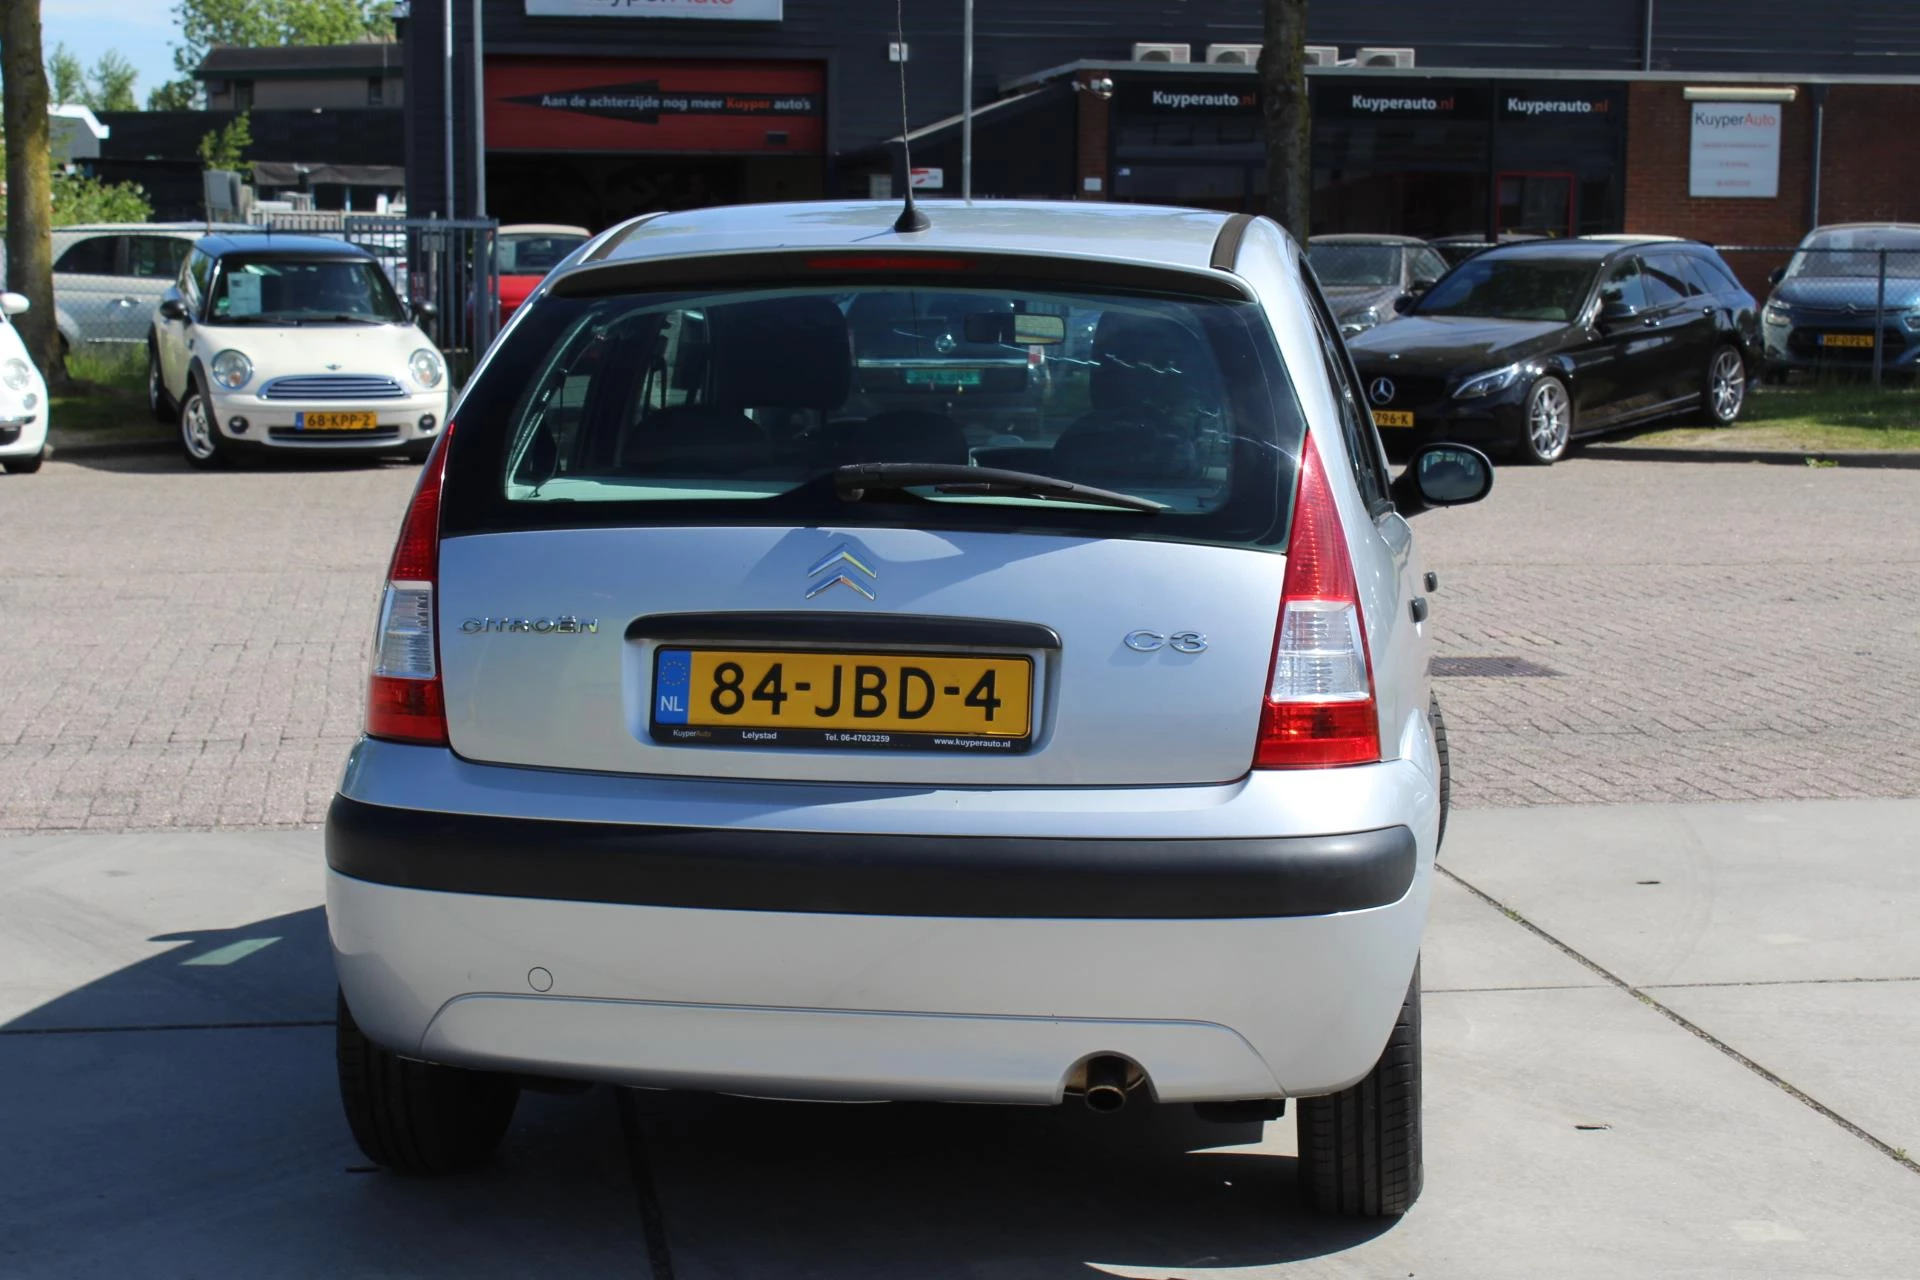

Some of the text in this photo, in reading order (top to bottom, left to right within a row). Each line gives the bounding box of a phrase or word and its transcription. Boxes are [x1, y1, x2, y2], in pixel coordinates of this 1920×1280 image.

[542, 95, 811, 111] Aan de achterzijde nog meer Kuyper auto's
[1153, 90, 1256, 108] Kuyperauto.nl
[1352, 94, 1454, 112] Kuyperauto.nl
[1508, 98, 1608, 115] Kuyperauto.nl
[1695, 112, 1776, 128] KuyperAuto
[307, 414, 370, 426] 68-KPP-2
[1123, 629, 1209, 654] C3
[710, 661, 1001, 722] 84-JBD-4
[660, 695, 684, 712] NL
[742, 731, 778, 740] Lelystad
[825, 733, 839, 742] Tel.
[934, 736, 1012, 748] www.kuyperauto.nl
